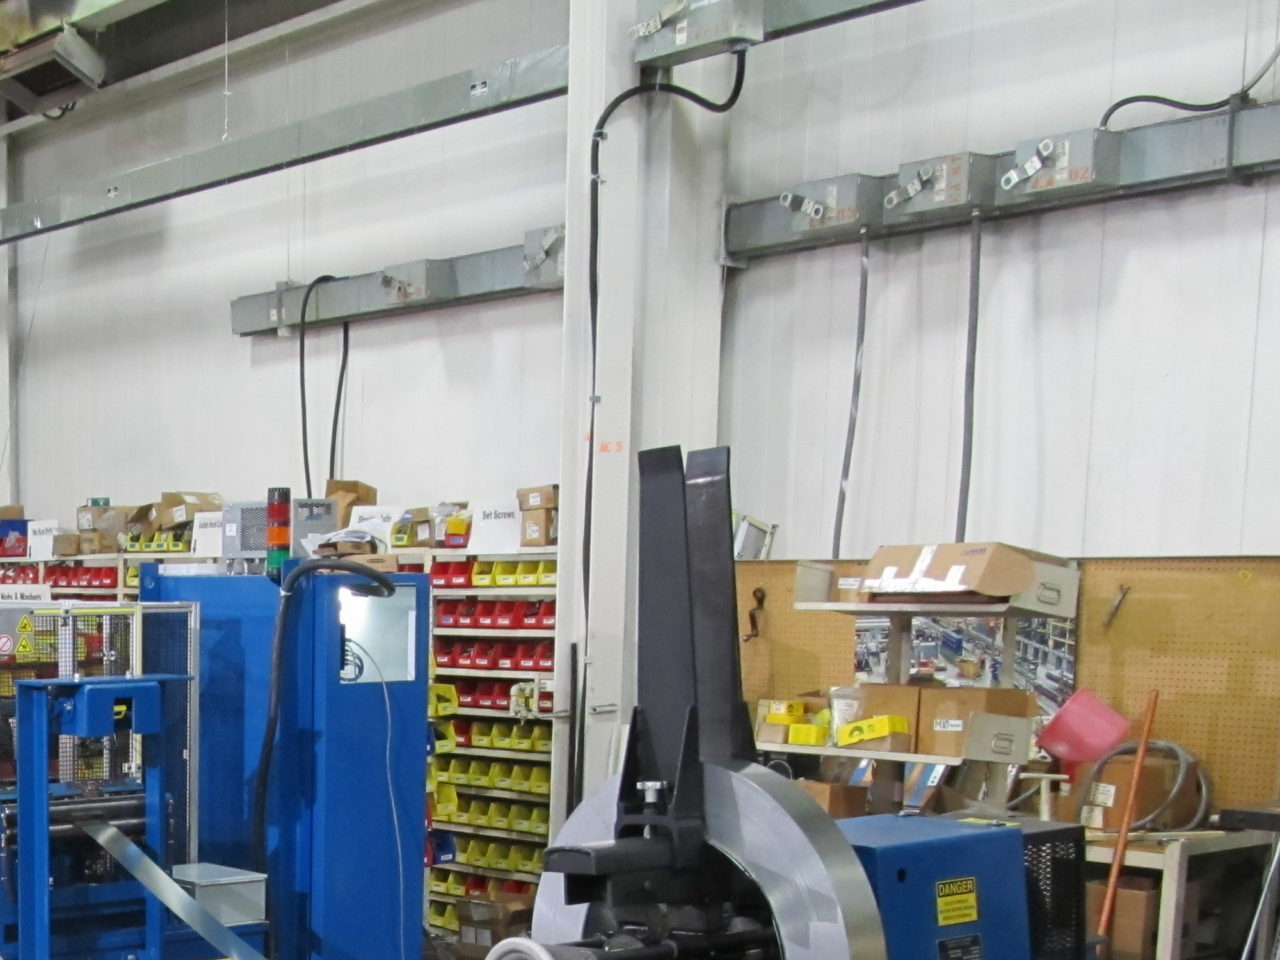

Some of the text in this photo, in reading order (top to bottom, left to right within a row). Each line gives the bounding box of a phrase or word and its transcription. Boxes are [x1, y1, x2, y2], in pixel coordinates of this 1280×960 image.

[482, 510, 515, 520] Set Screws
[938, 880, 974, 896] DANGER
